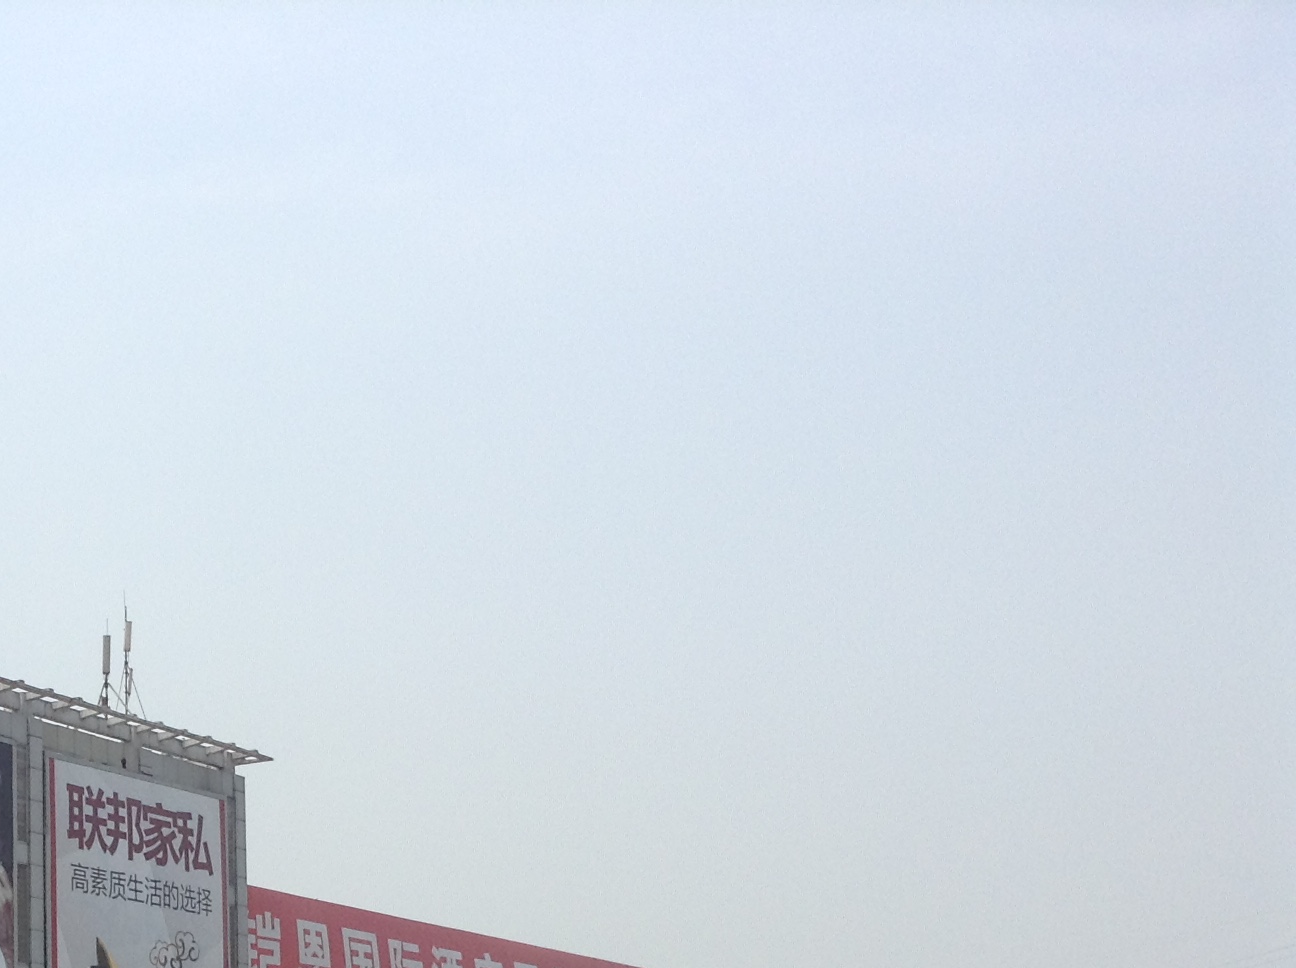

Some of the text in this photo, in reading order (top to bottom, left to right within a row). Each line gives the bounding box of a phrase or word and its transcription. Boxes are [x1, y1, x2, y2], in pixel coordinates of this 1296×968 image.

[66, 782, 214, 877] 联邦家私
[70, 862, 213, 917] 高素质生活的选择
